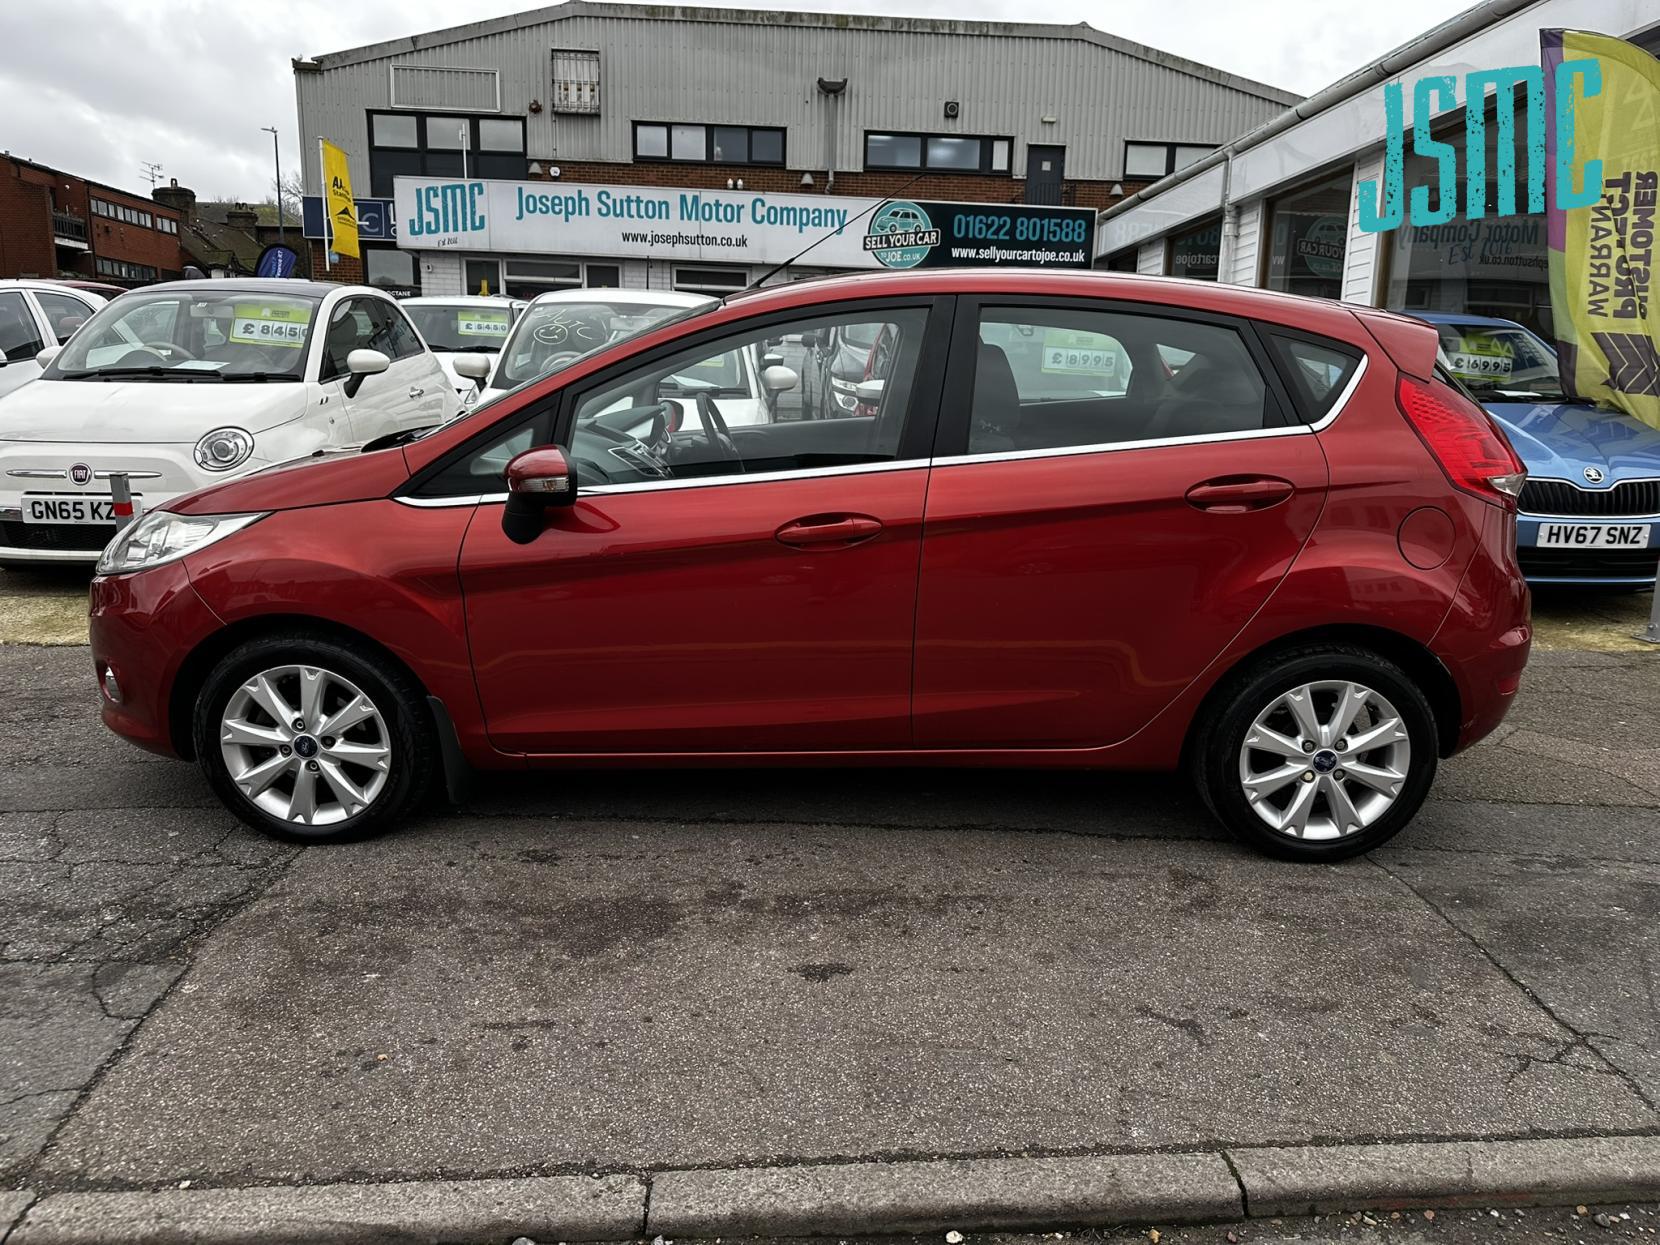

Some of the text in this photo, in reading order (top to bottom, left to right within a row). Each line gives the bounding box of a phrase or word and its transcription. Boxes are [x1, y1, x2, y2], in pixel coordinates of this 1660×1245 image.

[409, 183, 487, 237] JSMC
[516, 186, 848, 235] Joseph Sutton Motor Company
[953, 214, 1087, 243] 01622 801588
[621, 230, 748, 248] www.josephsutton.co.uk
[865, 232, 937, 249] SELL YOUR CAR
[951, 245, 1086, 264] www.sellyourcartojoe.co.uk
[73, 469, 87, 480] FIAT
[31, 501, 116, 520] GN65 KZ
[1546, 525, 1643, 545] HV67 SNZ
